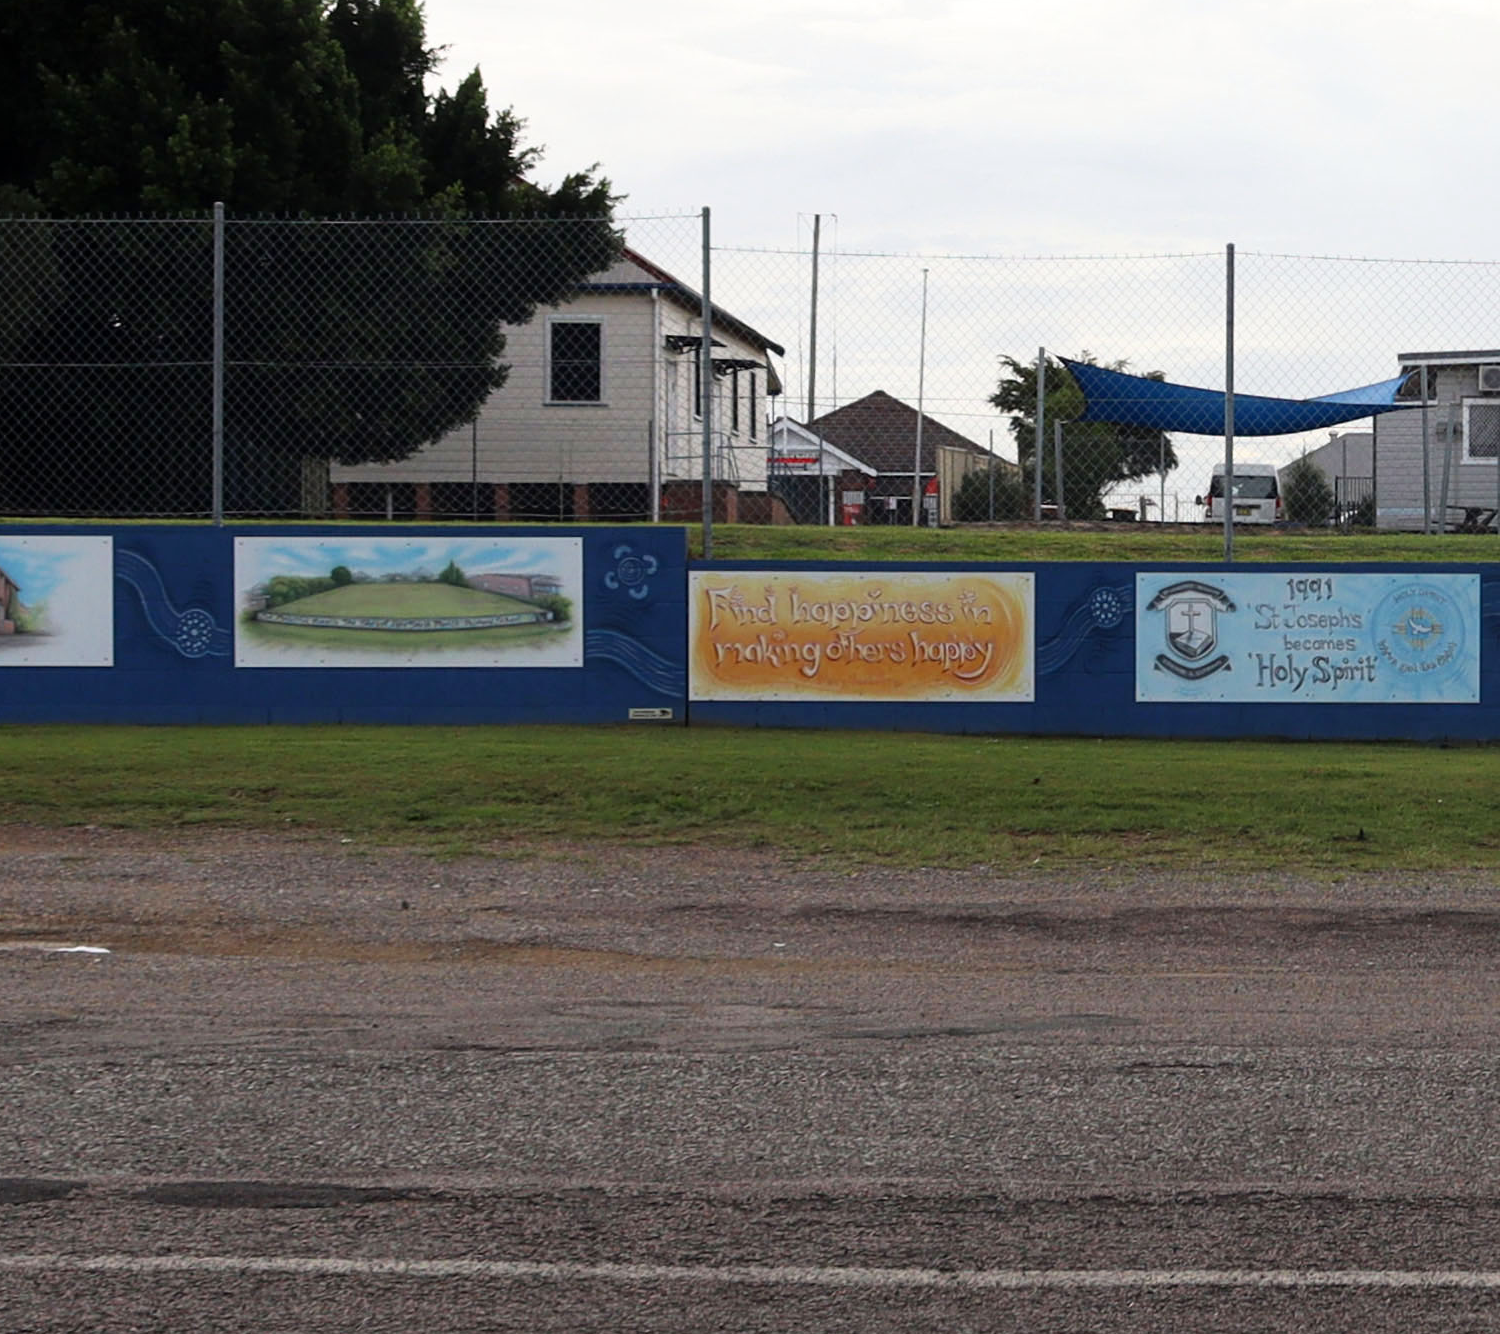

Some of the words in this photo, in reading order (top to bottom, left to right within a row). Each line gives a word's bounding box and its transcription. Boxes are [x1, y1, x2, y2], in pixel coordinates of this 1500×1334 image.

[1286, 578, 1332, 601] 1991
[706, 586, 776, 632] Find
[789, 585, 955, 630] happiness
[957, 589, 994, 626] in
[714, 630, 821, 679] making
[825, 627, 907, 663] others
[910, 630, 993, 684] happy
[1283, 634, 1357, 652] becomes
